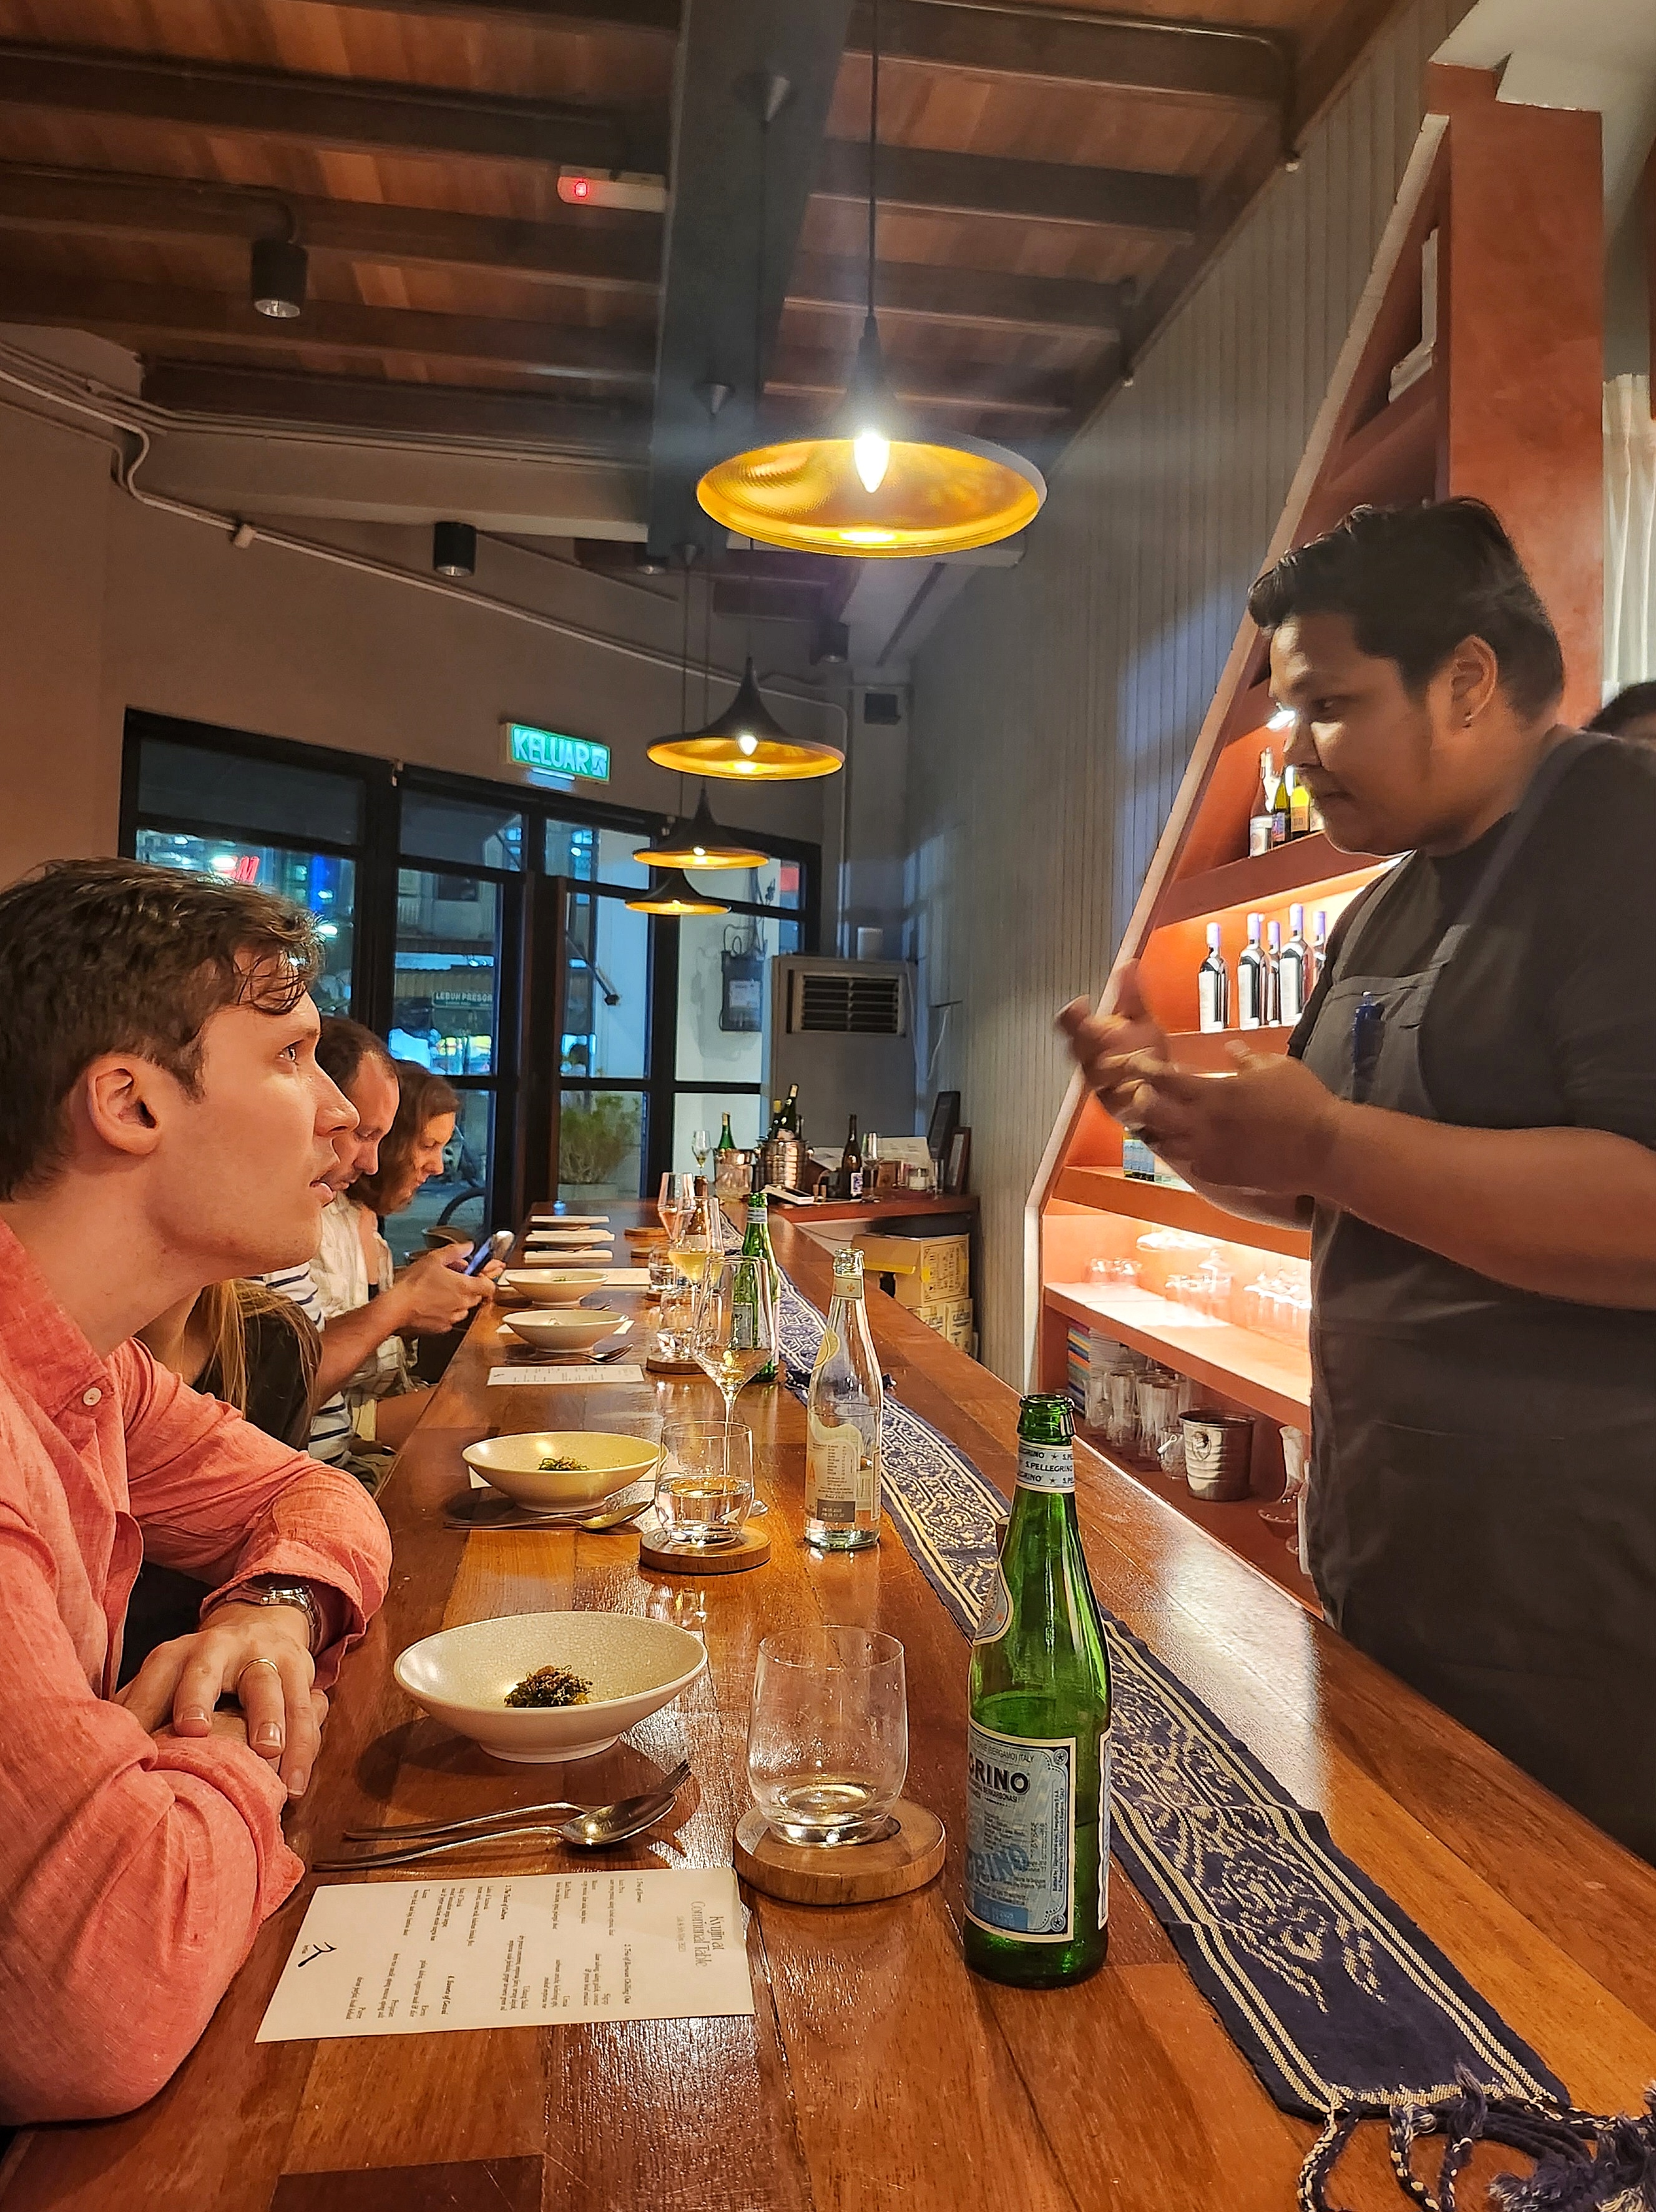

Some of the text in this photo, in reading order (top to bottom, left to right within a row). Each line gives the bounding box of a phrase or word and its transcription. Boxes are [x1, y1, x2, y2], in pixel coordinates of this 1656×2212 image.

[514, 728, 589, 774] KELUAR
[691, 1901, 712, 1967] Communal Table
[712, 1942, 724, 1950] at
